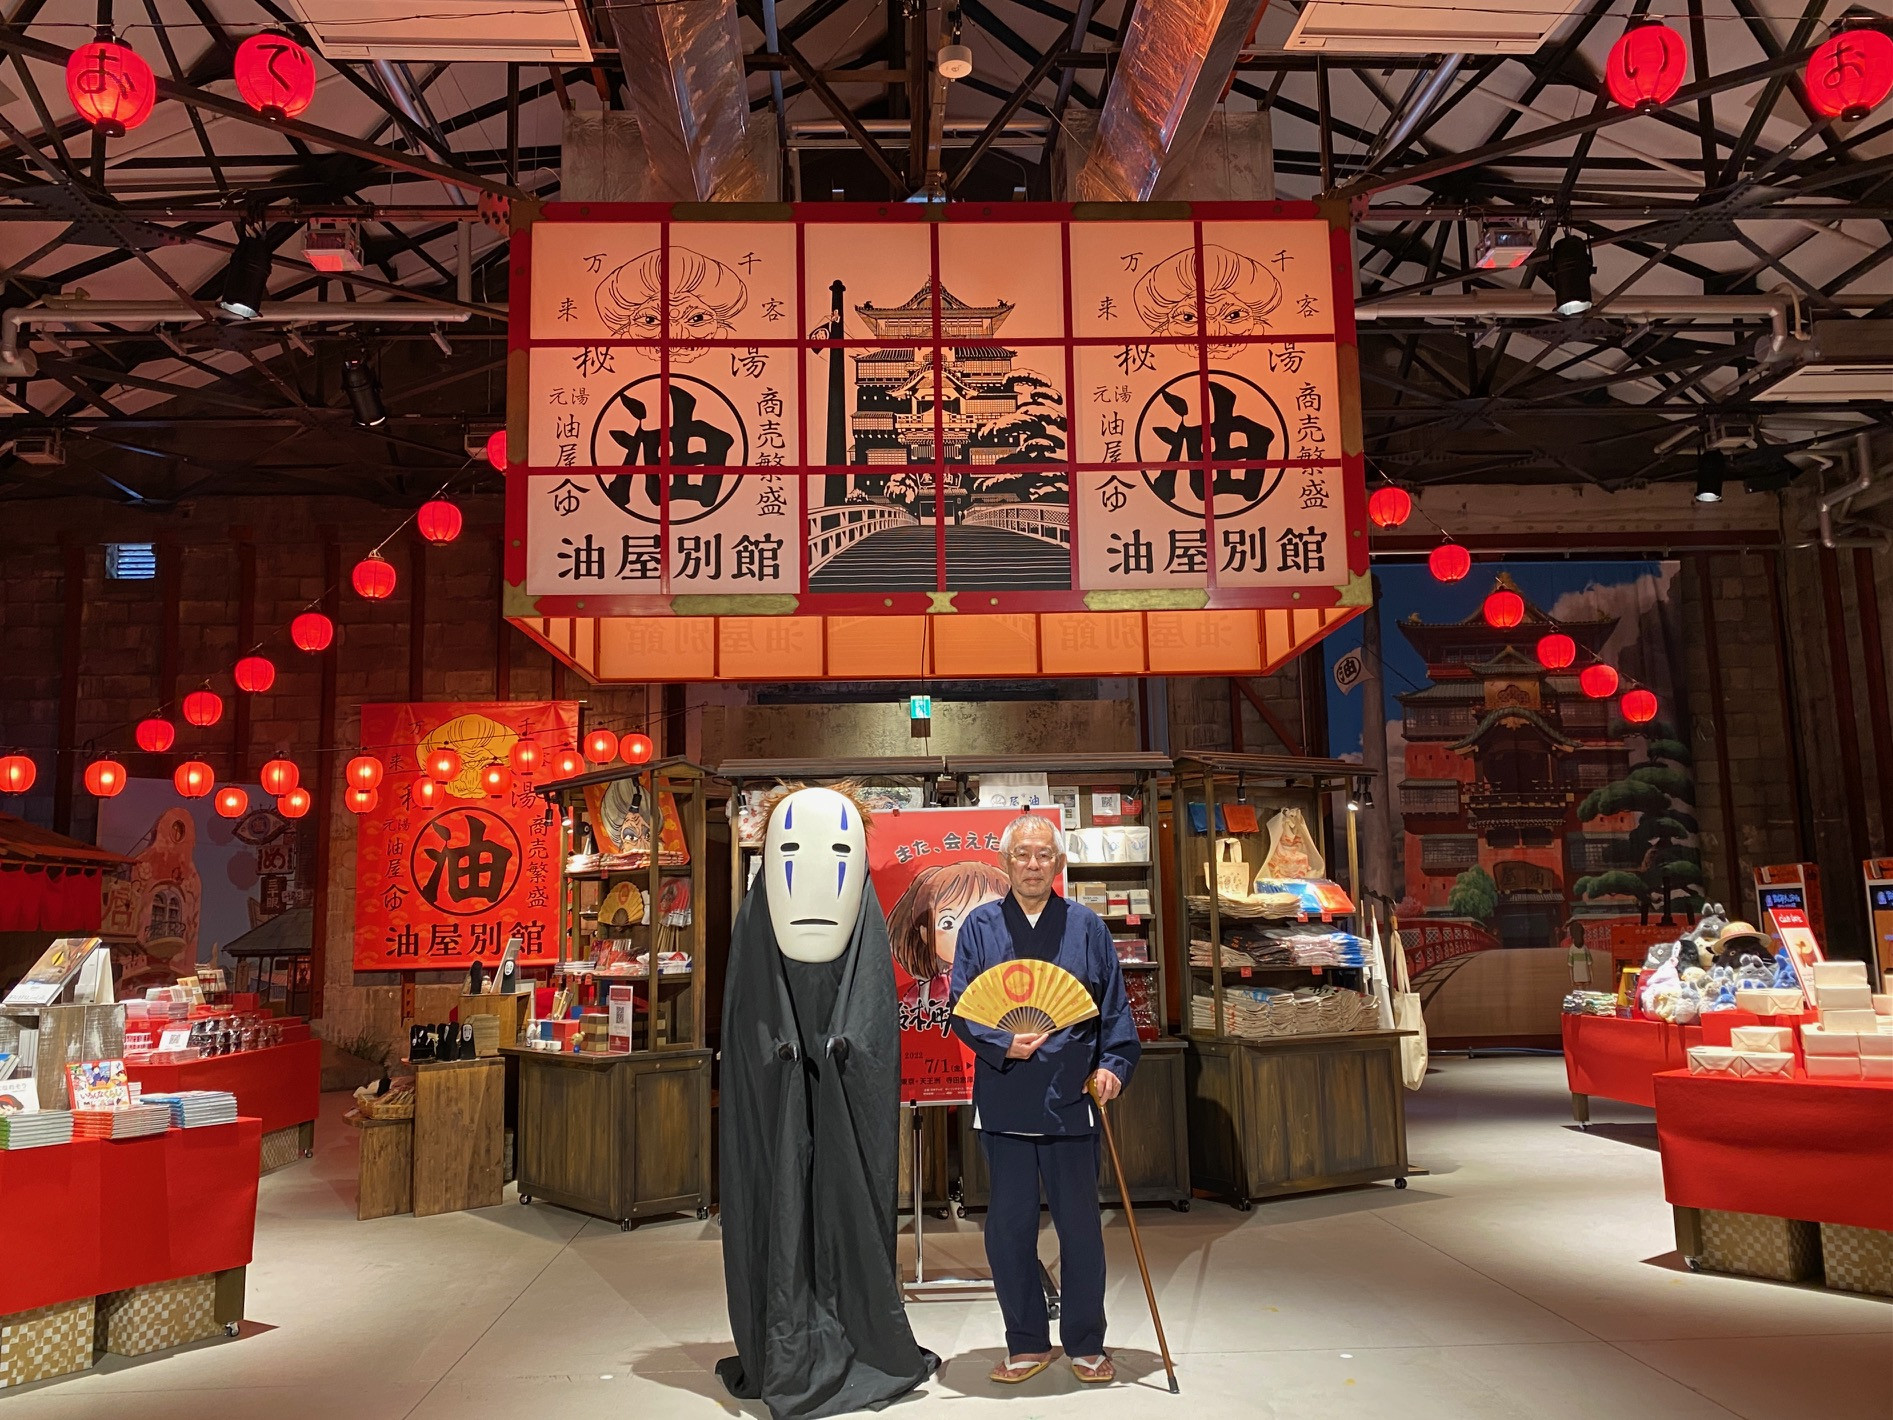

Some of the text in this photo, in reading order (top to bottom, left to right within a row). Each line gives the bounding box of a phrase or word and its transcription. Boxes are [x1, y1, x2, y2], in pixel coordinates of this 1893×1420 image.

[1622, 35, 1670, 81] い
[1822, 39, 1867, 90] お
[583, 252, 607, 274] 万
[738, 252, 761, 275] 千
[1120, 252, 1144, 273] 万
[1271, 250, 1294, 272] 千
[557, 298, 578, 322] 来
[761, 298, 785, 322] 客
[1097, 296, 1119, 321] 来
[1296, 294, 1320, 318] 客
[549, 387, 590, 406] 元湯
[1093, 385, 1133, 404] 元湯
[608, 384, 735, 508] 油
[755, 387, 787, 517] 商売繁盛
[1152, 380, 1276, 502] 油
[1296, 382, 1329, 510] 商売繁盛
[557, 533, 784, 582] 油屋別館
[1107, 525, 1328, 575] 油屋別館
[1338, 659, 1358, 682] 油
[388, 754, 404, 772] 来
[382, 818, 411, 832] 元湯
[263, 848, 286, 870] め
[421, 814, 513, 904] 油
[527, 815, 549, 909] 商売繁盛
[386, 920, 547, 958] 油屋別館
